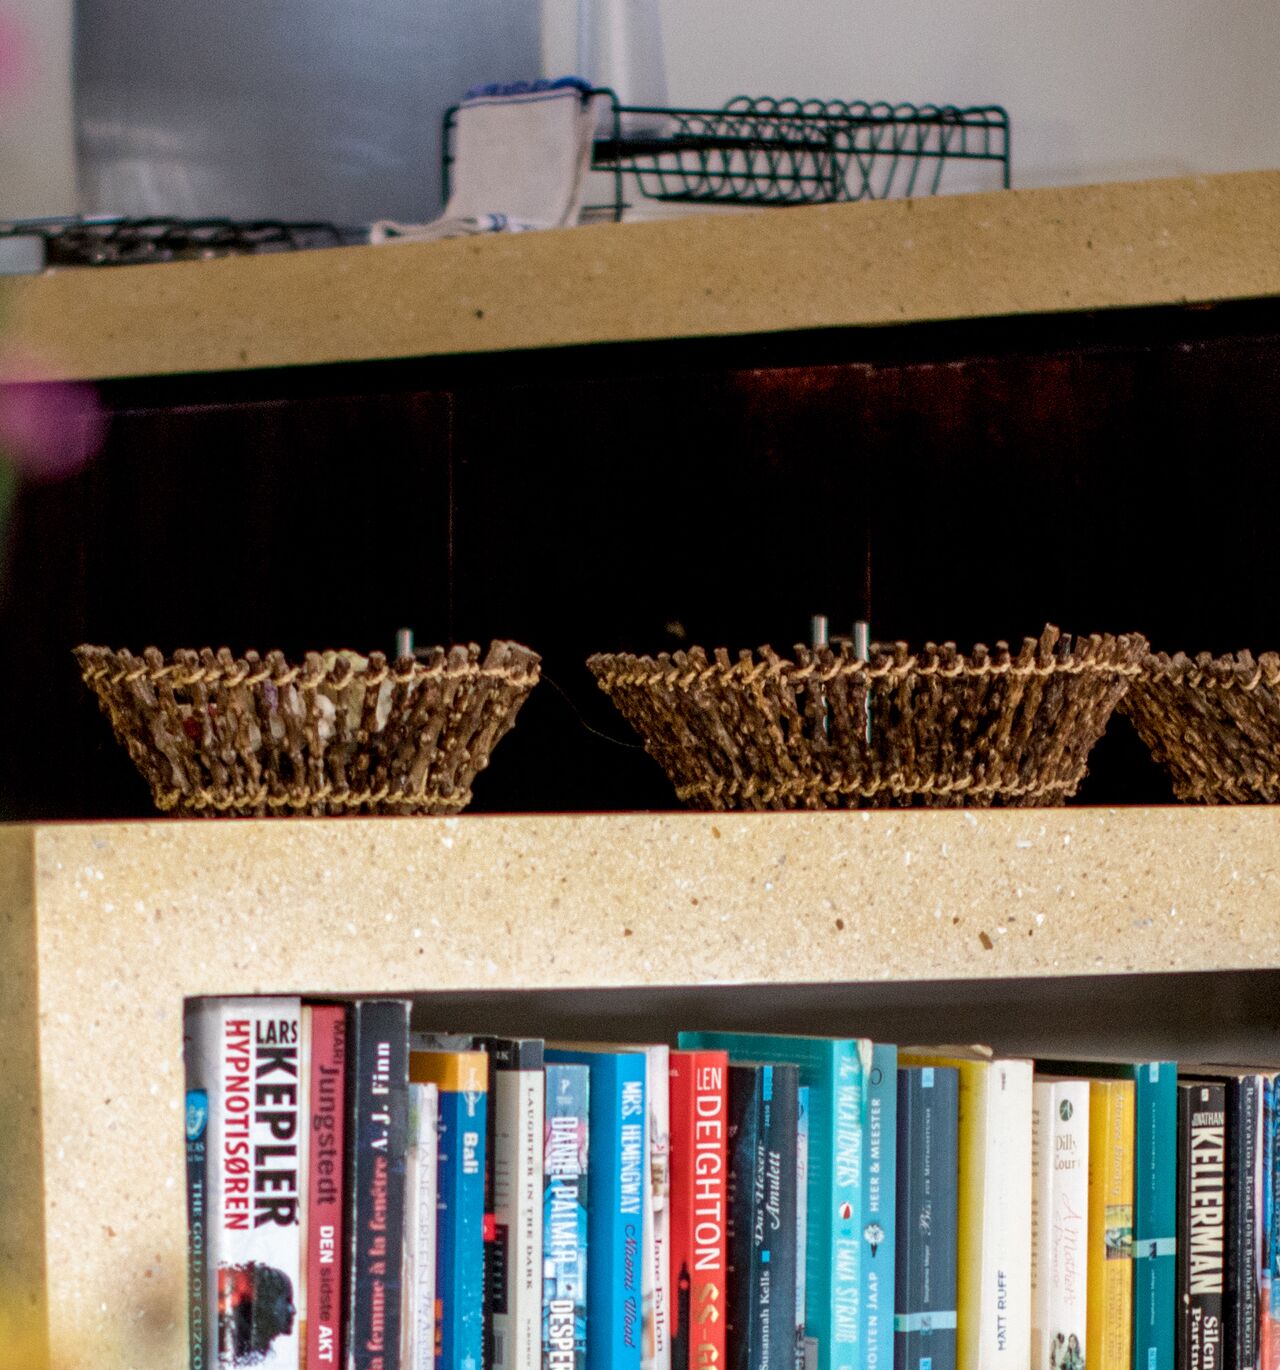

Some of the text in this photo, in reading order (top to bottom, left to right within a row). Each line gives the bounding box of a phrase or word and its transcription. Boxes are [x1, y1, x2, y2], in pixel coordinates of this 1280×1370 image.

[256, 1019, 298, 1044] LARS
[332, 1020, 344, 1065] MARI
[370, 1041, 392, 1153] A. J. Finn
[696, 1066, 722, 1091] LEN
[224, 1019, 252, 1231] HYPNOTISØREN
[253, 1047, 299, 1230] KEPLER
[314, 1064, 340, 1205] Jungstedt
[462, 1132, 480, 1175] Bali
[620, 1081, 642, 1215] MRS. HEMINGWAY
[869, 1098, 882, 1159] MEESTER
[1191, 1111, 1224, 1127] JONATHAN
[1245, 1086, 1255, 1168] Reservation
[368, 1158, 389, 1232] fenêtre
[525, 1088, 535, 1291] LAUGHTER IN THE DARK
[550, 1116, 579, 1263] DANIEL PALMER
[694, 1094, 723, 1272] DEIGHTON
[765, 1150, 781, 1231] Amulett
[869, 1175, 881, 1213] HEER
[1189, 1126, 1225, 1295] KELLERMAN
[1245, 1175, 1255, 1214] Road
[368, 1236, 387, 1256] la
[754, 1208, 765, 1247] Das
[1245, 1218, 1254, 1246] John
[192, 1181, 204, 1370] THE GOLD OF CUZCO
[318, 1225, 335, 1363] DEN sidste AKT
[368, 1261, 388, 1276] à
[622, 1223, 639, 1348] Naomi Wood
[653, 1238, 666, 1353] Jane Fallon
[758, 1270, 771, 1305] Kells
[833, 1237, 860, 1344] EMMA STRAUB
[865, 1271, 879, 1311] JAAP
[1245, 1249, 1254, 1300] Burnham
[366, 1284, 386, 1352] femme
[996, 1269, 1008, 1352] MATT RUFF
